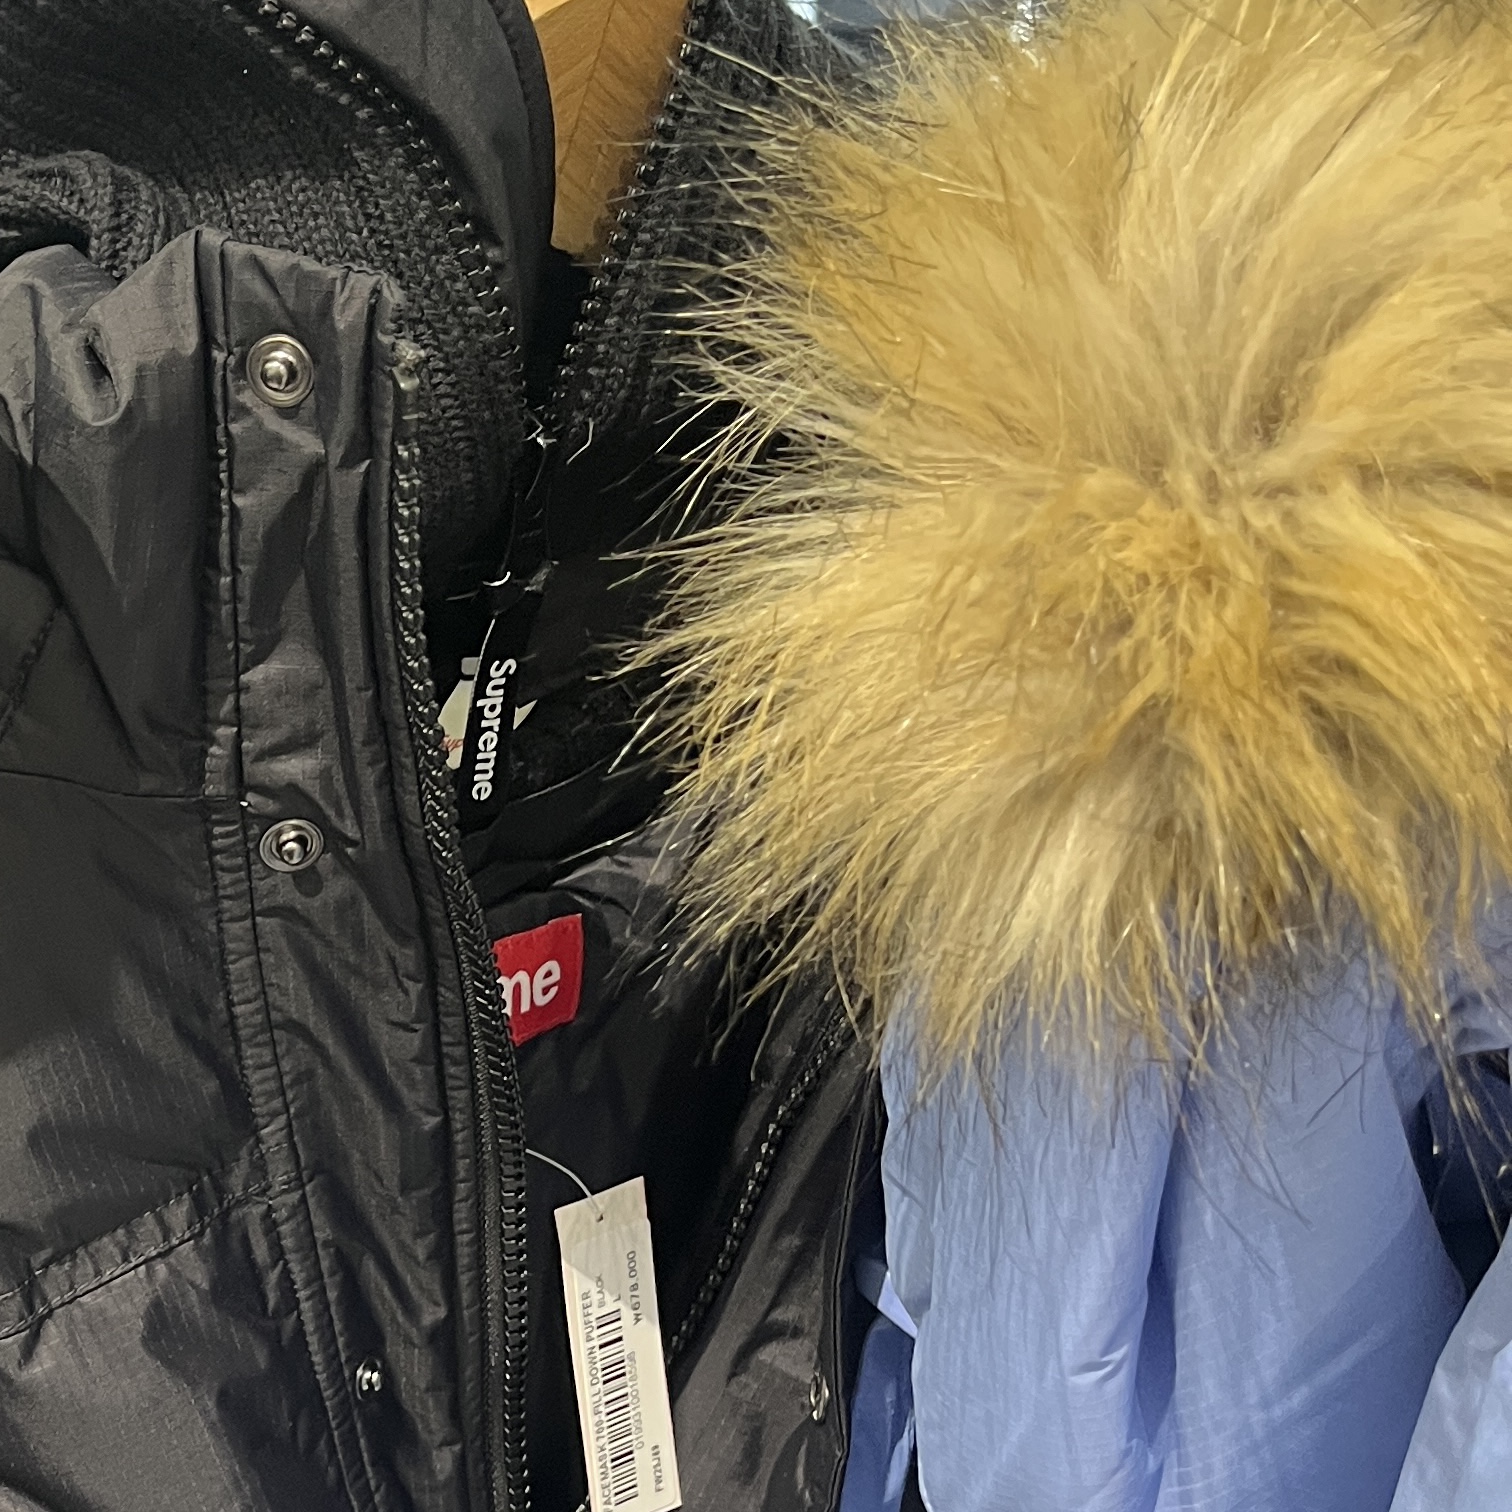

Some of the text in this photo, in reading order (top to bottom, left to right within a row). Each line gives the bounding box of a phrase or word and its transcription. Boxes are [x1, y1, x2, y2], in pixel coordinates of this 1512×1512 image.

[472, 658, 517, 801] Supreme
[595, 1273, 606, 1309] BLACK
[613, 1293, 621, 1303] L
[581, 1290, 595, 1343] PUFFER
[587, 1345, 600, 1387] DOWN
